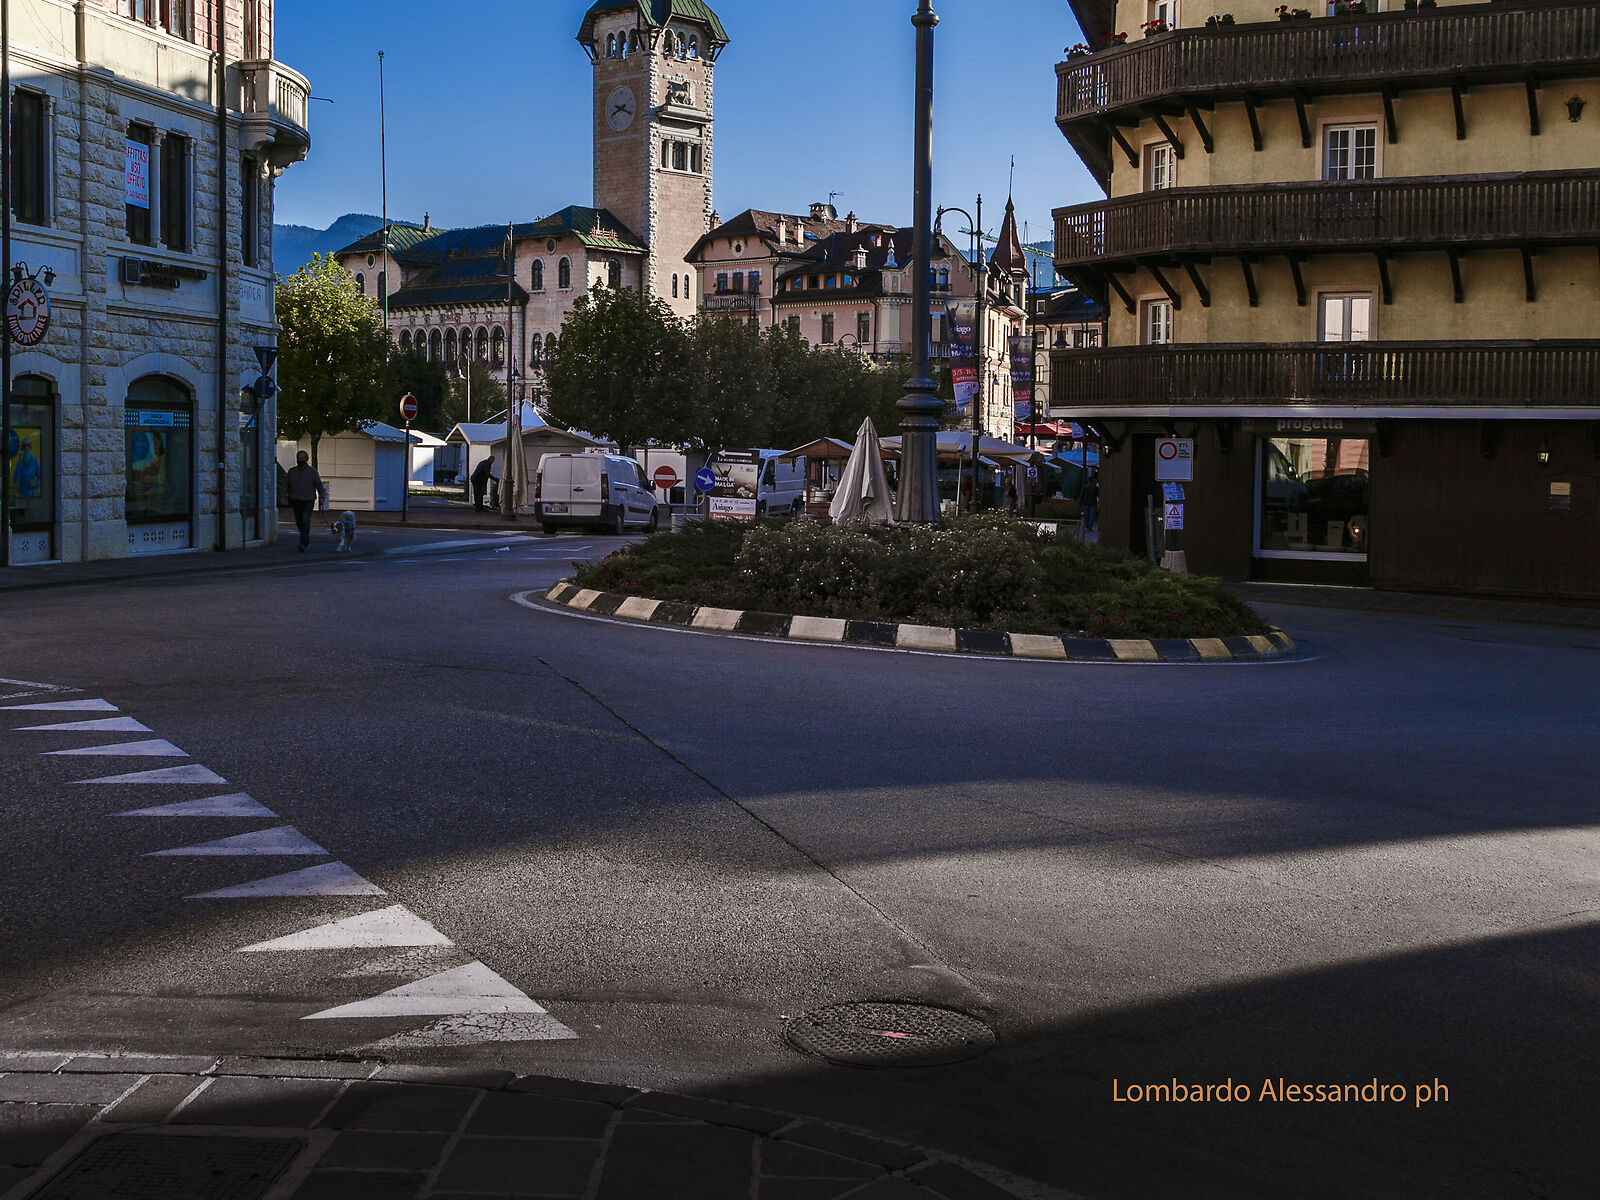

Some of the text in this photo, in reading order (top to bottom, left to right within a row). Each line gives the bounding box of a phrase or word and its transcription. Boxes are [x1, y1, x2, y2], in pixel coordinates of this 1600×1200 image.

[130, 161, 141, 175] USO
[126, 172, 145, 189] UFFICIO
[7, 314, 48, 343] IMMOBILIARE
[1277, 418, 1344, 432] progetta
[712, 503, 733, 512] Asiago
